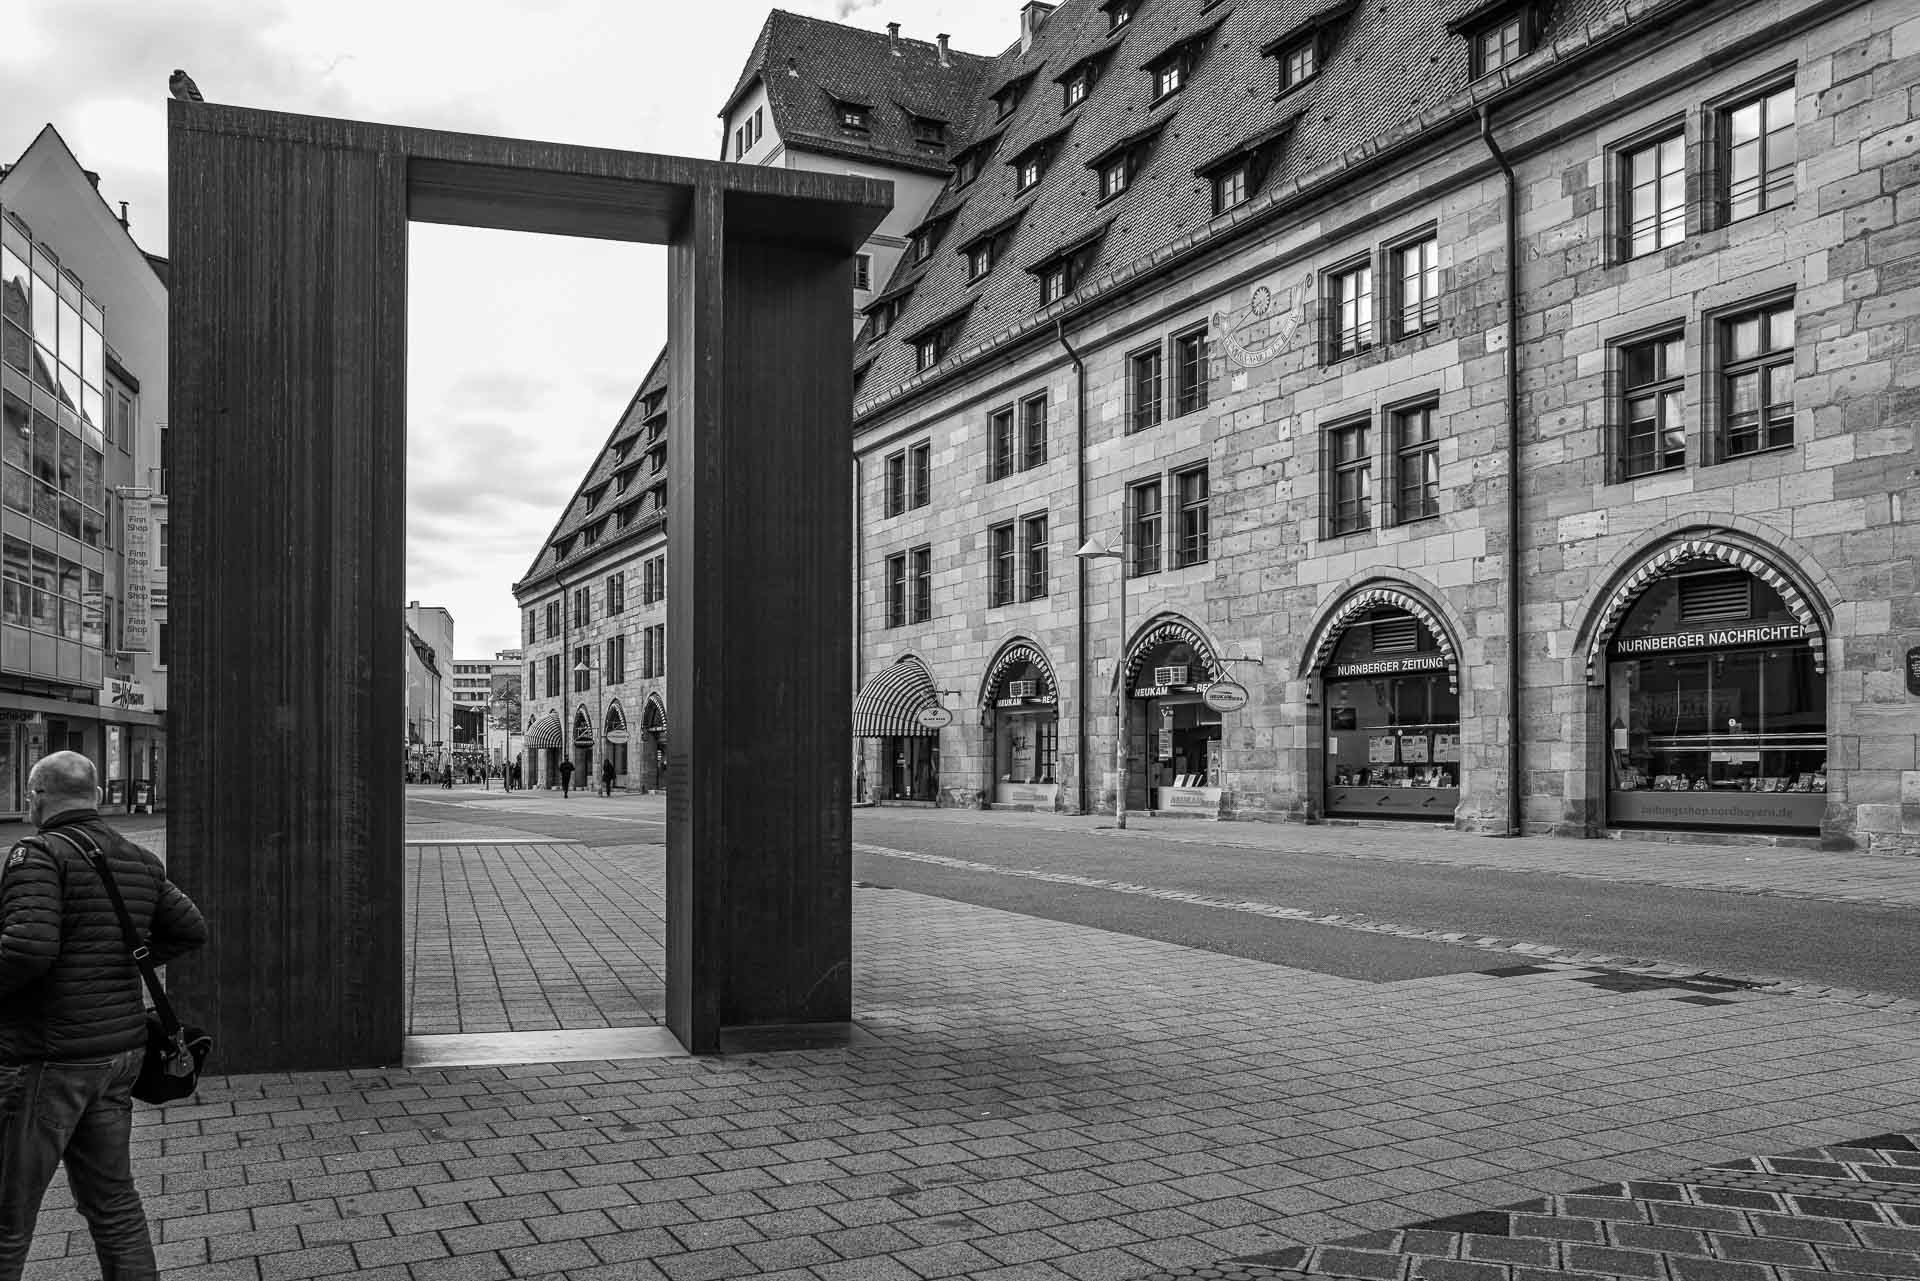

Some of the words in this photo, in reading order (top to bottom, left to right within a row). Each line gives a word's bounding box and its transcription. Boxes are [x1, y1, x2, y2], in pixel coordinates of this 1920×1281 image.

[127, 524, 148, 533] Shop
[127, 558, 148, 567] Shop
[128, 583, 146, 591] Finn
[127, 592, 148, 601] Shop
[128, 617, 146, 625] Finn
[127, 625, 148, 635] Shop
[1401, 657, 1443, 671] ZEITUNG
[1134, 686, 1168, 697] NEUKAM
[996, 698, 1022, 708] NEUKAM
